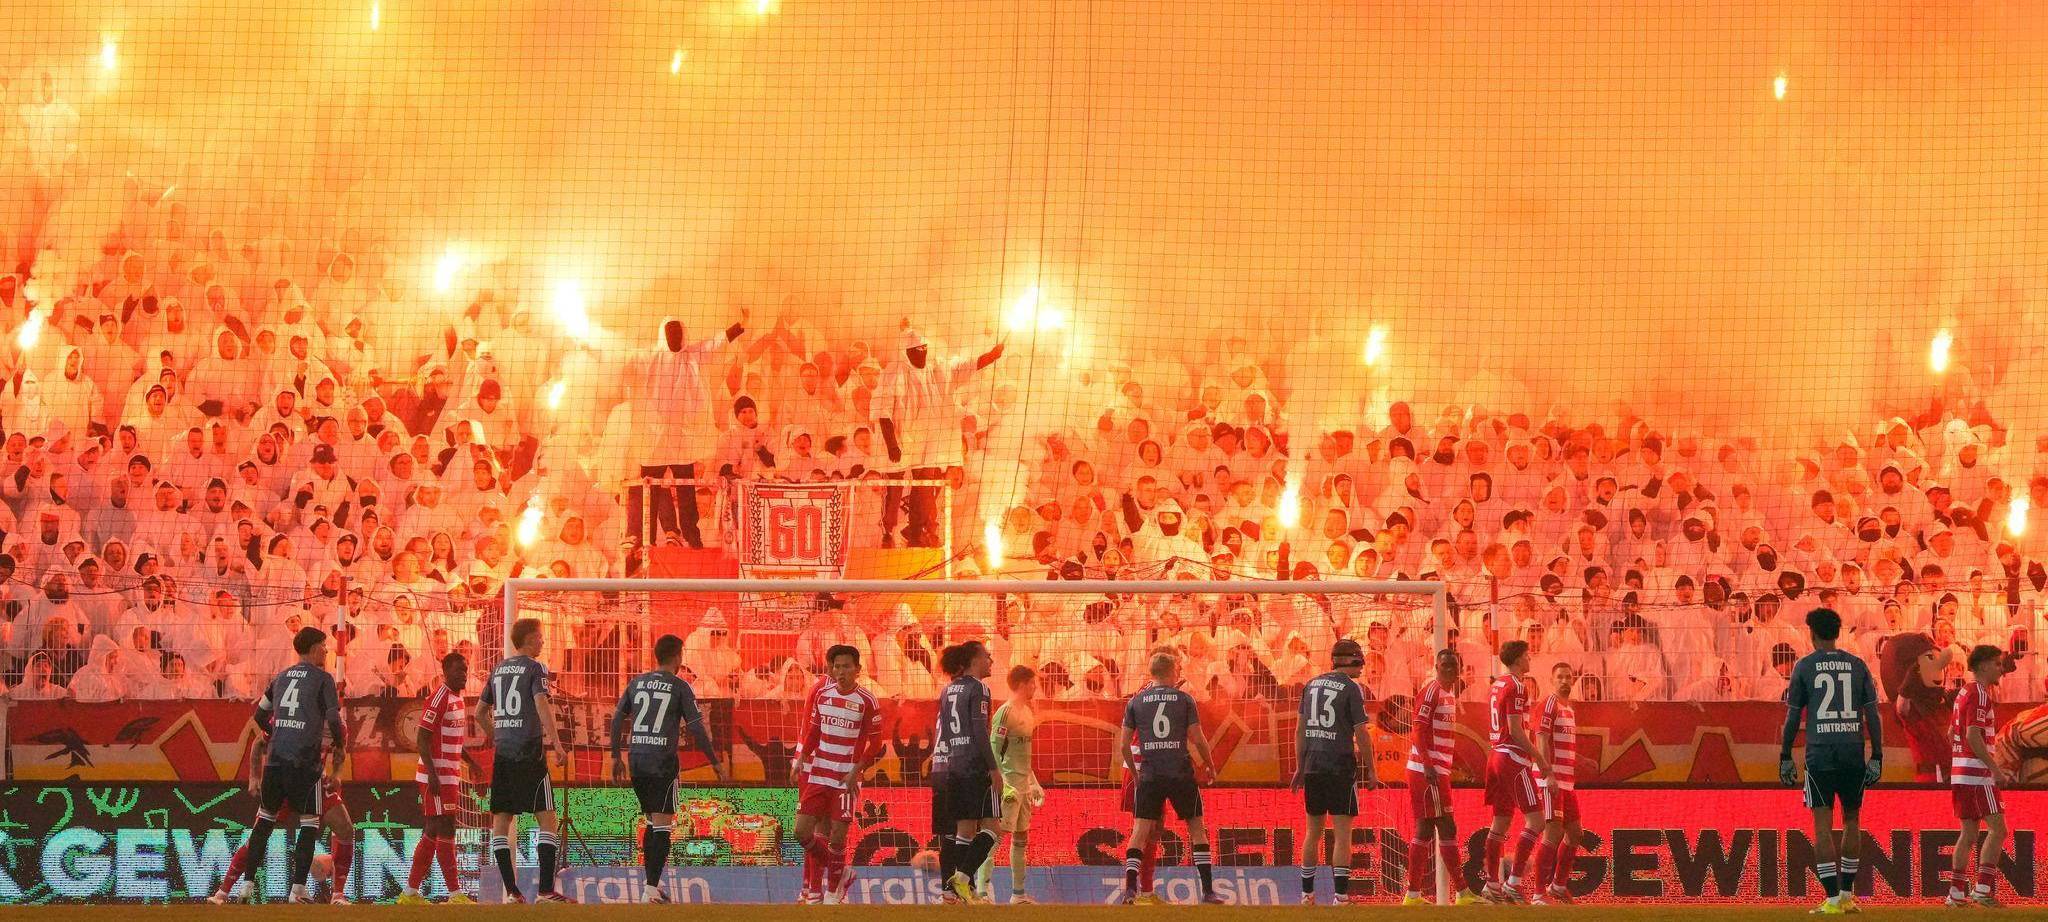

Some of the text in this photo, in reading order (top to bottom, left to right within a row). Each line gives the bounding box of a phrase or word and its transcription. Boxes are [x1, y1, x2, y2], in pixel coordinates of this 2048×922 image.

[769, 505, 822, 560] 60
[495, 666, 526, 675] LARSSON
[1815, 661, 1852, 671] BROWN
[286, 670, 308, 678] KOCH
[647, 679, 673, 692] GÖTZE
[279, 678, 300, 717] 4
[493, 675, 522, 717] 16
[1142, 694, 1178, 703] HØJLUND
[1814, 672, 1857, 719] 21
[633, 690, 671, 734] 27
[947, 694, 961, 734] 3
[1307, 687, 1338, 728] 13
[1152, 701, 1171, 739] 6
[1305, 729, 1337, 740] EINTRACHT
[1816, 722, 1861, 734] EINTRACHT
[631, 735, 668, 746] EINTRACHT
[1144, 740, 1181, 751] EINTRACHT
[838, 793, 852, 811] 11
